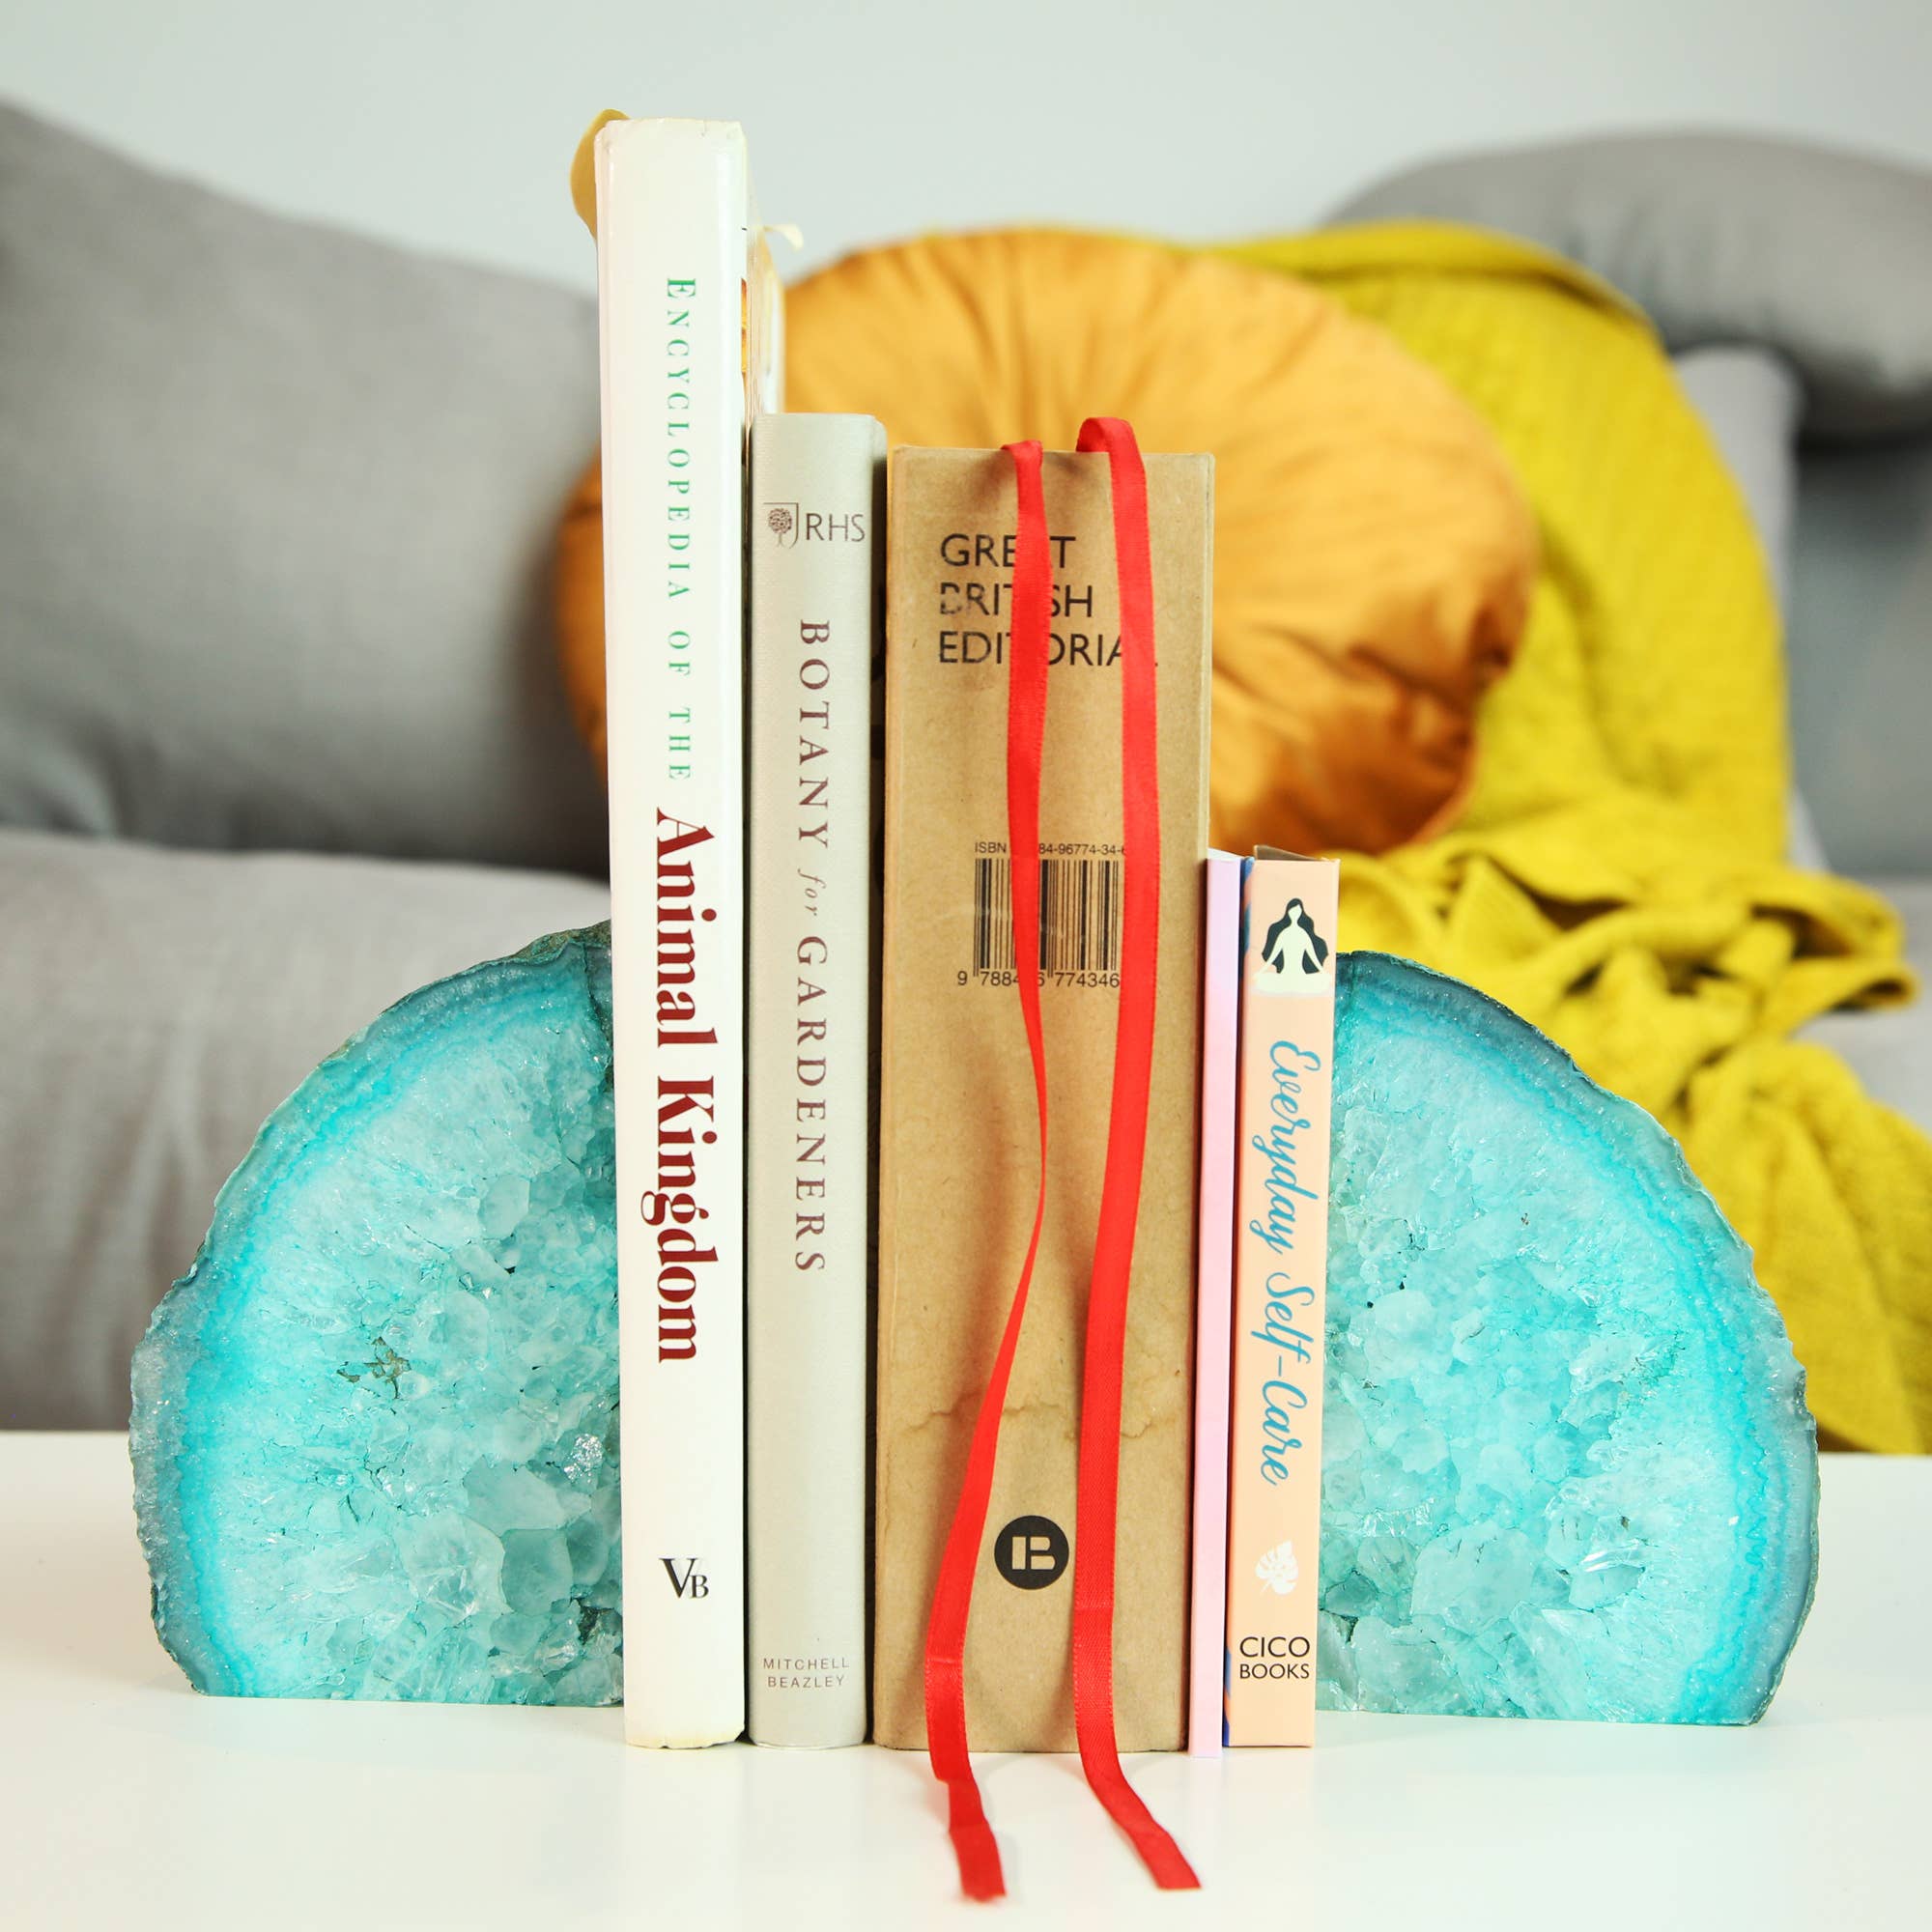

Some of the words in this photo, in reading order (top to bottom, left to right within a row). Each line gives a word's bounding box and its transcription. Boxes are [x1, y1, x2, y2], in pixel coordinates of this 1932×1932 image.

[667, 278, 696, 598] ENCYCLOPEDIA
[805, 512, 866, 543] RHS
[940, 532, 1077, 569] GRET
[668, 630, 691, 675] OF
[668, 707, 692, 779] THE
[798, 619, 831, 849] BOTANY
[974, 841, 1007, 854] ISBN
[797, 867, 826, 917] for
[655, 806, 719, 1049] Animal
[957, 970, 968, 986] 9
[1055, 972, 1121, 988] 774346
[793, 934, 828, 1272] GARDENERS
[1248, 1038, 1322, 1256] Everyday
[639, 1074, 720, 1364] Kingdom
[1249, 1270, 1316, 1487] Self-Care
[763, 1657, 850, 1671] MITCHELL
[1239, 1635, 1311, 1659] CICO
[767, 1676, 845, 1690] BEAZLEY
[1239, 1662, 1310, 1680] BOOKS
